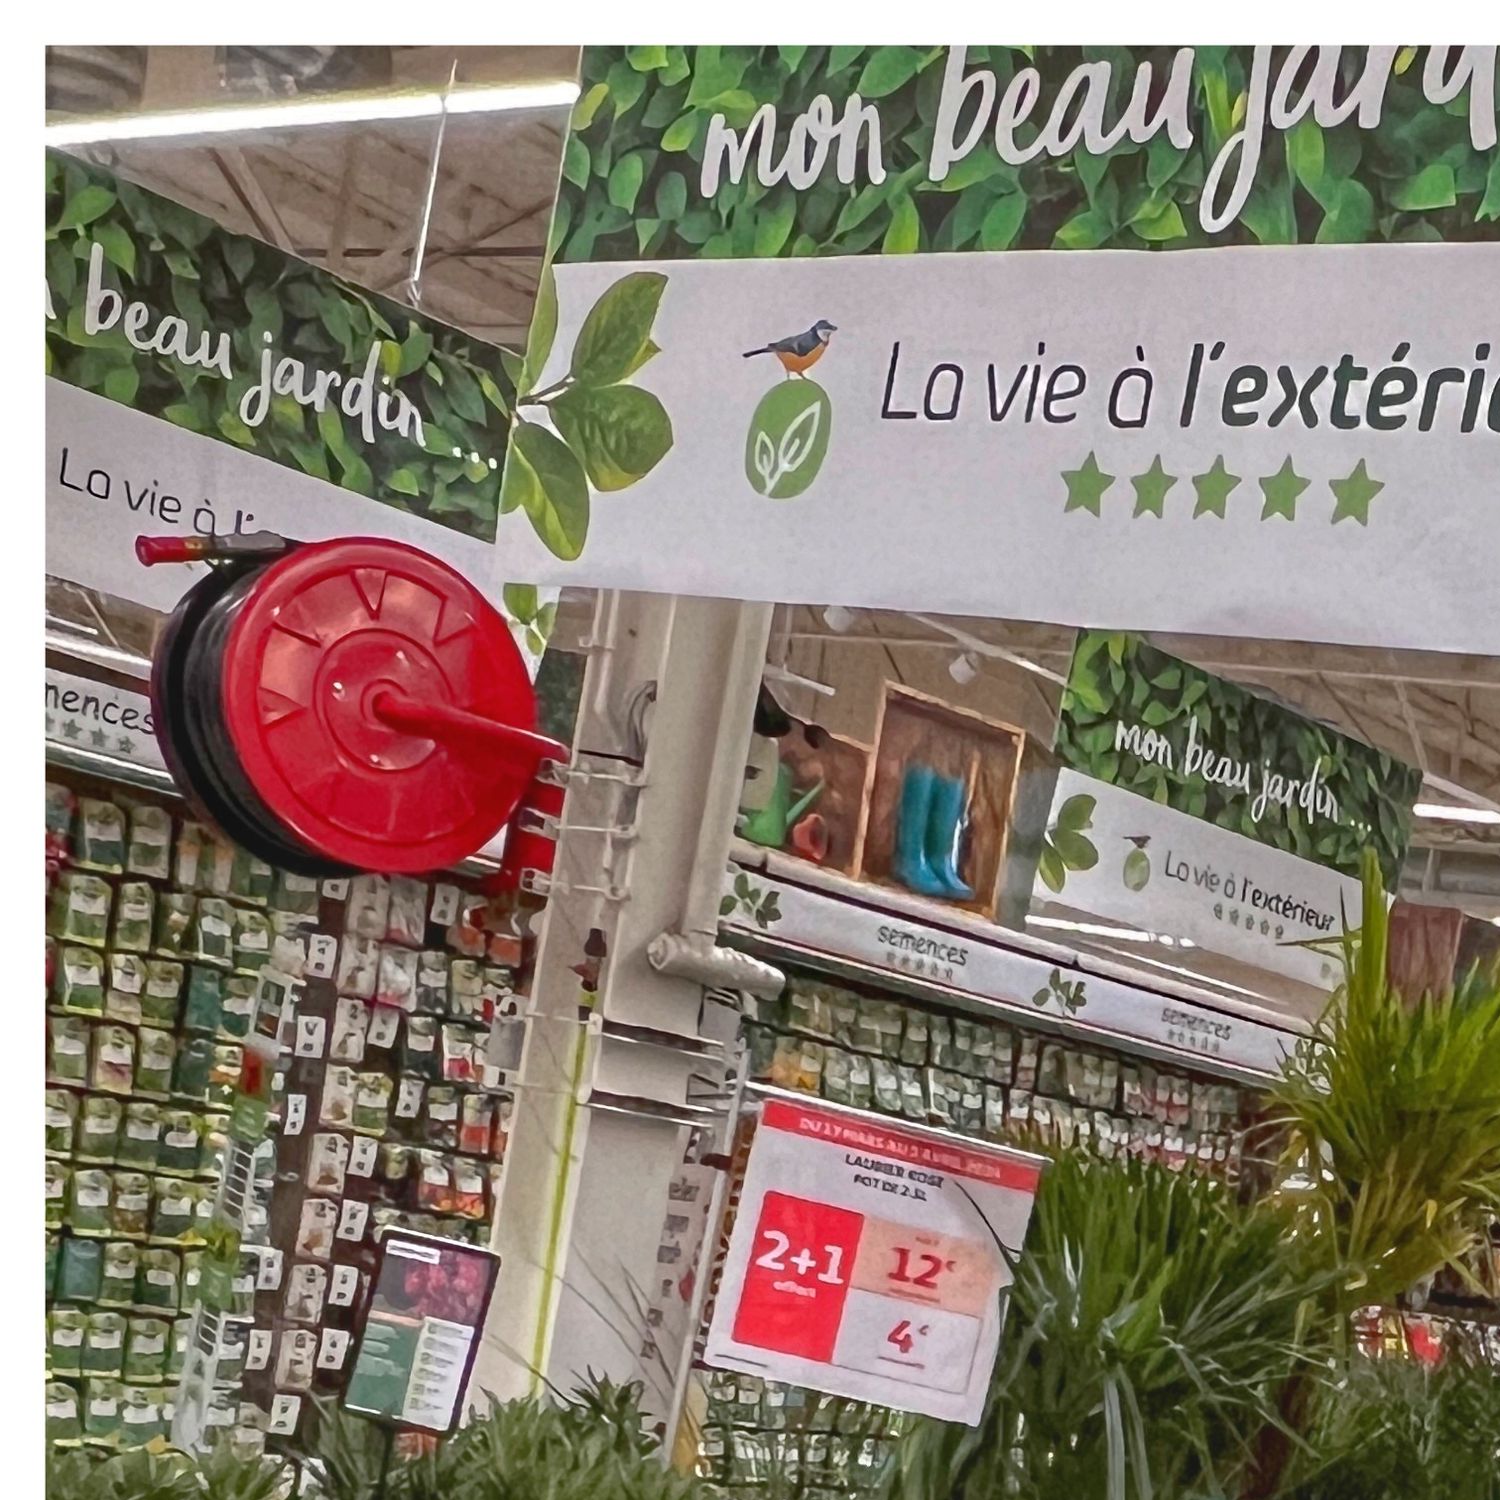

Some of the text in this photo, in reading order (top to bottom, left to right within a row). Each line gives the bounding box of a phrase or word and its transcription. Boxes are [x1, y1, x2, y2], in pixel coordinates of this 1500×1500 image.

[700, 93, 887, 199] mon
[928, 45, 1196, 182] beau
[84, 242, 233, 380] beau
[880, 341, 964, 422] La
[987, 341, 1087, 424] vie
[1107, 344, 1154, 429] à
[59, 447, 112, 500] La
[124, 479, 182, 524] vie
[193, 498, 216, 535] à
[1114, 718, 1173, 771] mon
[1184, 714, 1251, 796] beau
[1164, 850, 1336, 932] La vie à l'extérieur
[877, 923, 970, 968] semences
[755, 1229, 845, 1285] 2+1
